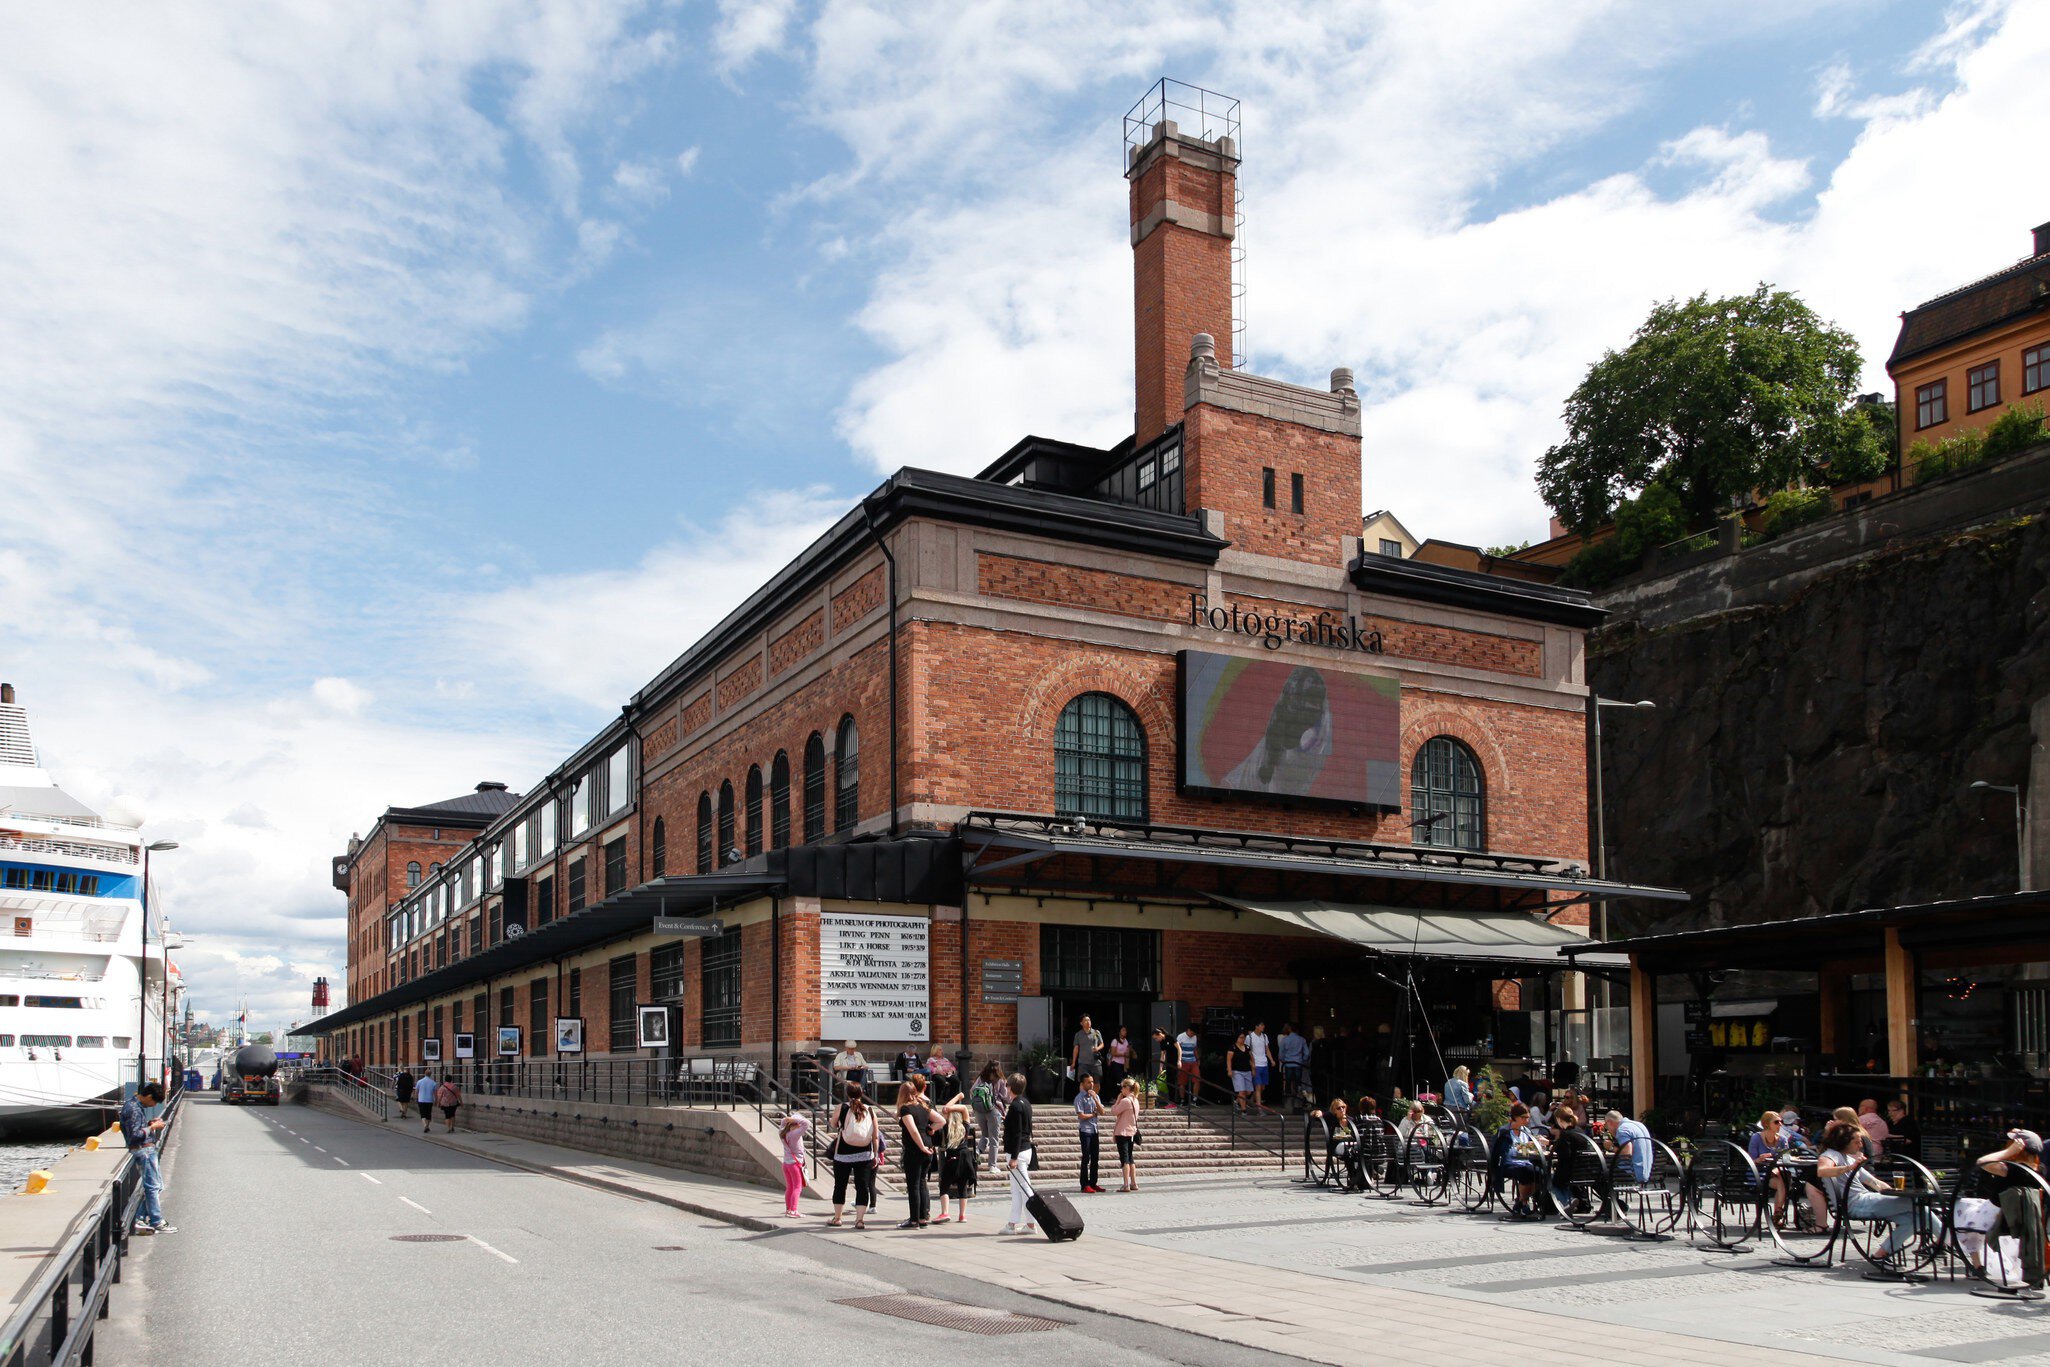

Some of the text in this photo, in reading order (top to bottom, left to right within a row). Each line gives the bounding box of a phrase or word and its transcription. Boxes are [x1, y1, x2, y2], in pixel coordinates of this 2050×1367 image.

[1189, 593, 1383, 653] Fotografiska
[835, 918, 864, 926] MUSEUM
[875, 920, 926, 929] PHOTOGRAPHY
[840, 930, 866, 938] IRVING
[870, 931, 890, 939] PENN
[840, 953, 874, 961] BERNING
[864, 960, 897, 968] BATTISTA
[1141, 976, 1151, 992] A
